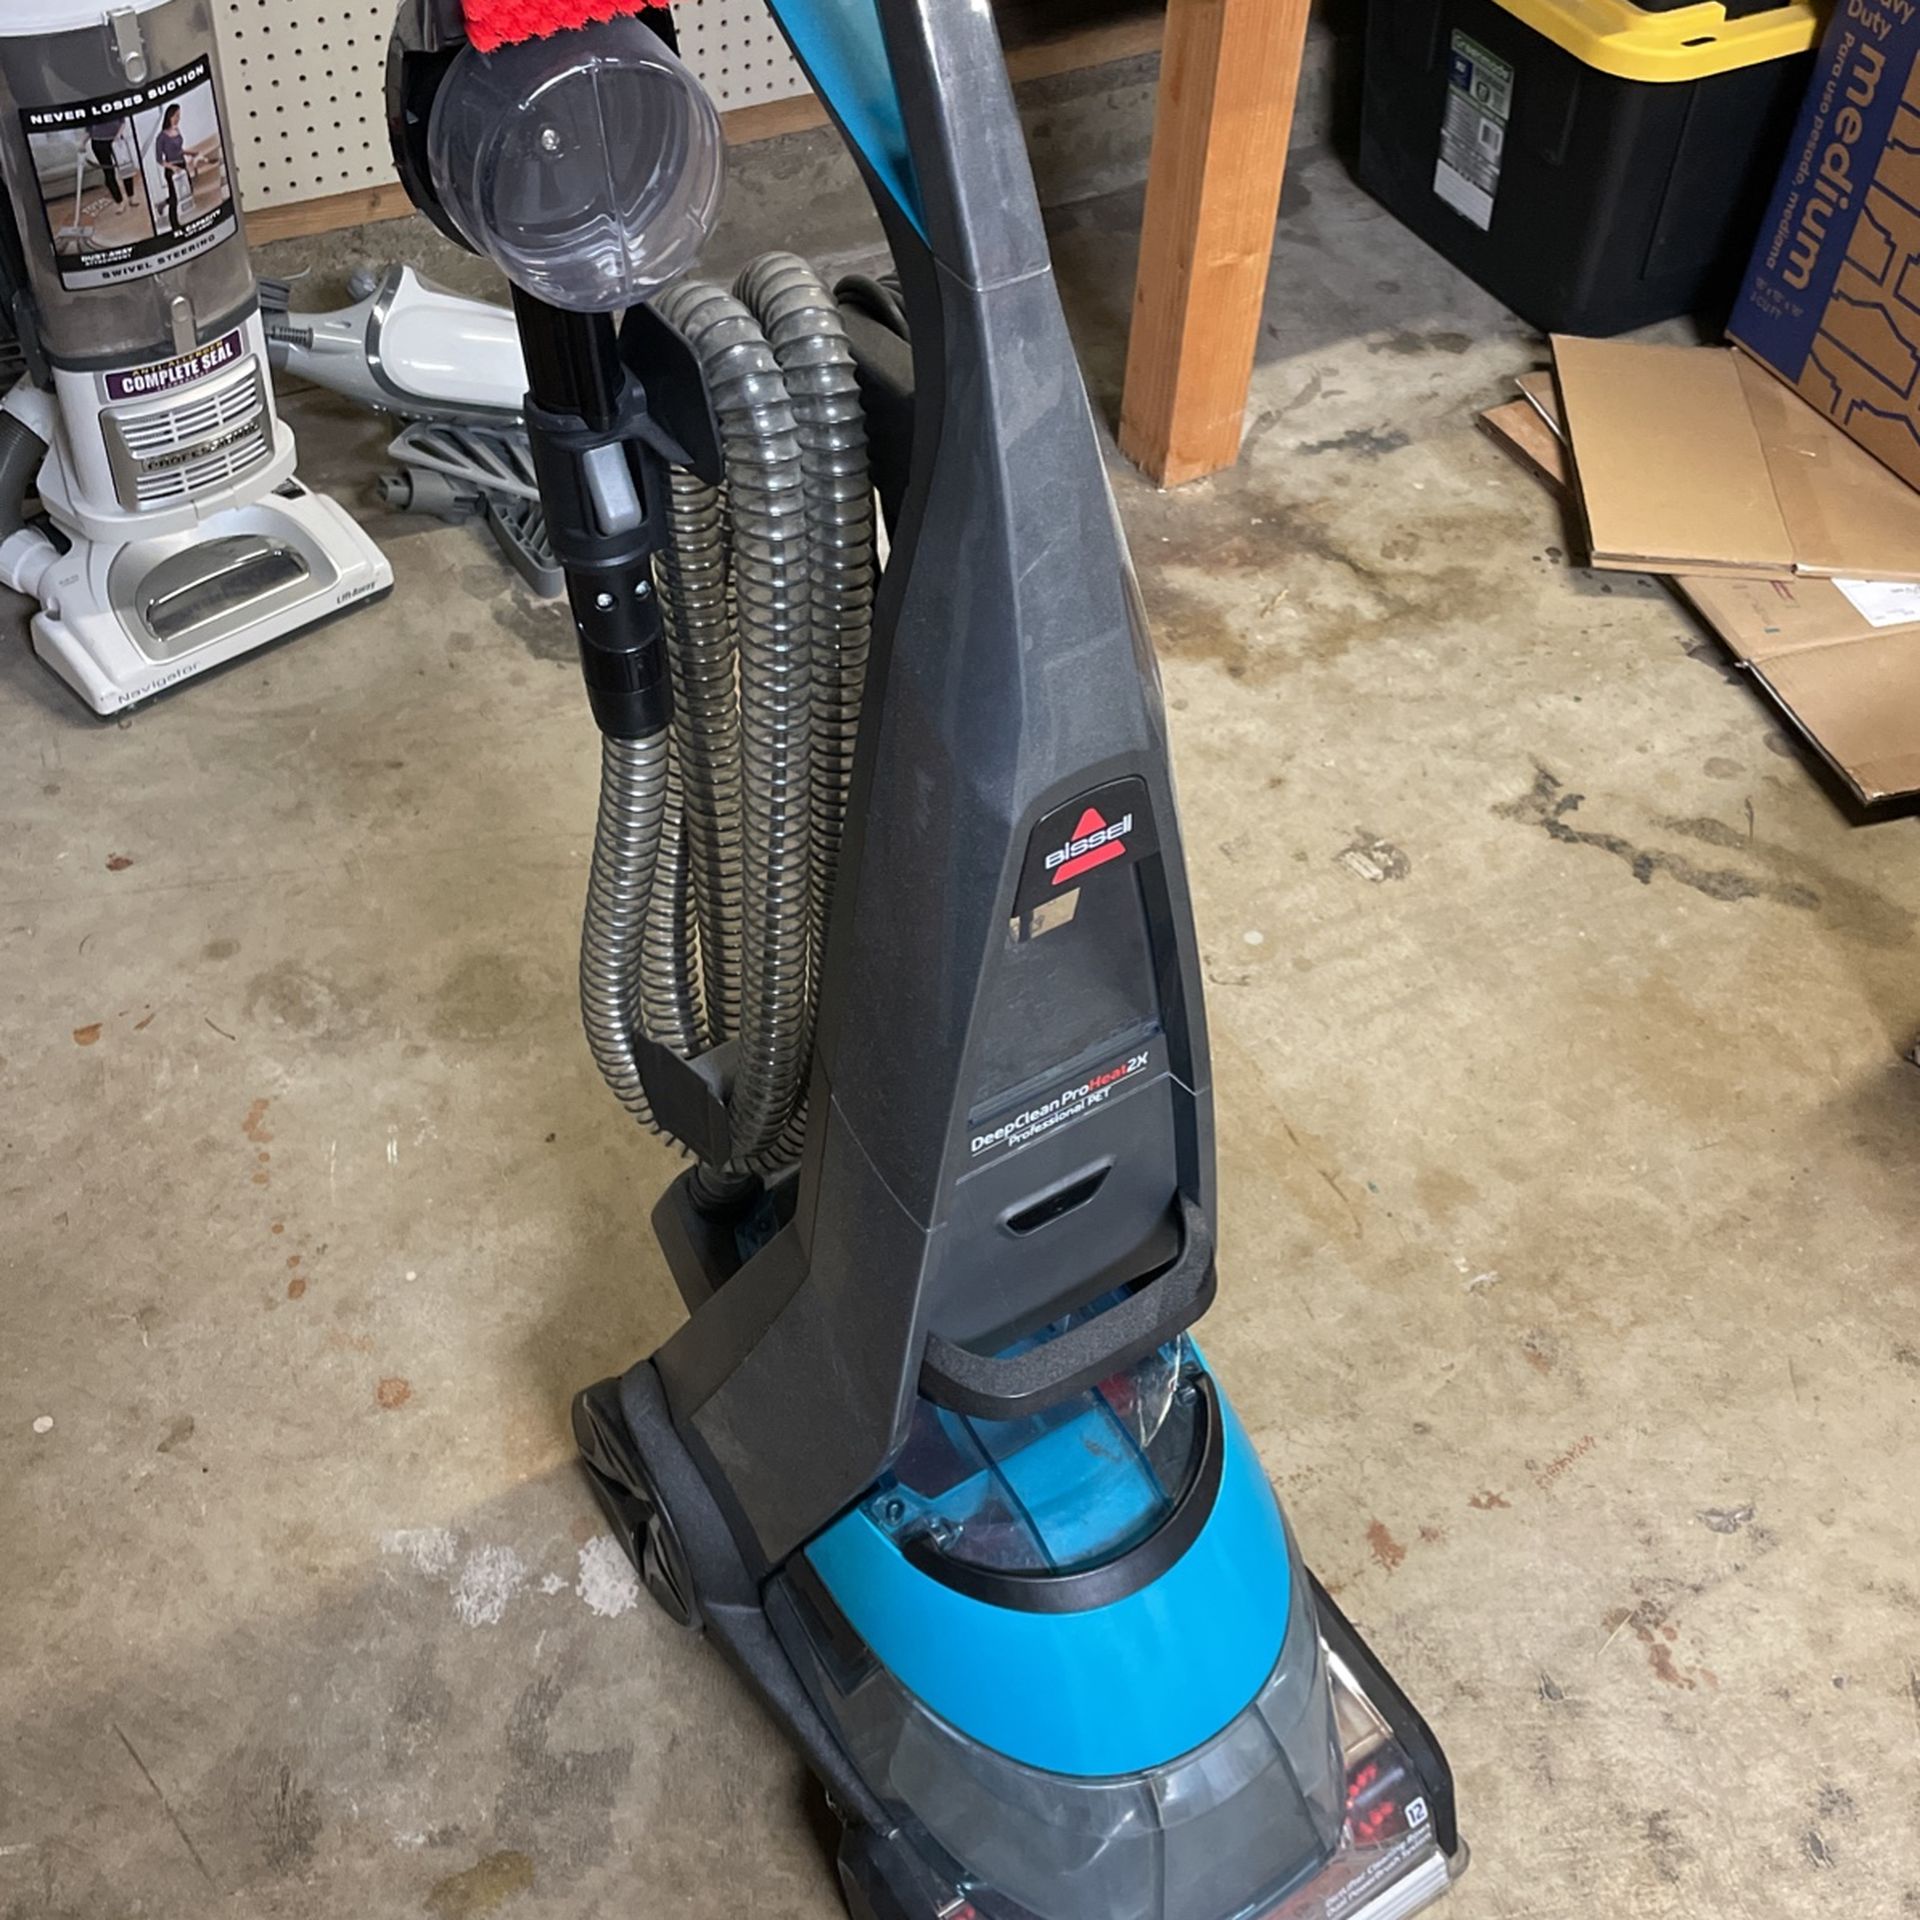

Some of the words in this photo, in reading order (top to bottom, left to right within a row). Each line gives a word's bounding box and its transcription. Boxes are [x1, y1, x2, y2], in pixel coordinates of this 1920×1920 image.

[1847, 0, 1892, 41] Duty
[1832, 32, 1856, 78] Para
[30, 109, 86, 124] NEVER
[91, 94, 144, 116] LOSES
[147, 65, 205, 100] SUCTION
[1820, 80, 1837, 114] uso
[1782, 43, 1887, 290] medium
[1766, 192, 1799, 270] mediana
[102, 262, 153, 279] SWIVEL
[157, 234, 215, 265] STEERING
[122, 358, 200, 393] COMPLETE
[202, 343, 233, 370] SEAL
[117, 662, 200, 704] Navigator
[971, 1098, 1060, 1152] DeepClean
[1008, 1100, 1085, 1147] Professional
[1408, 1803, 1425, 1823] 12
